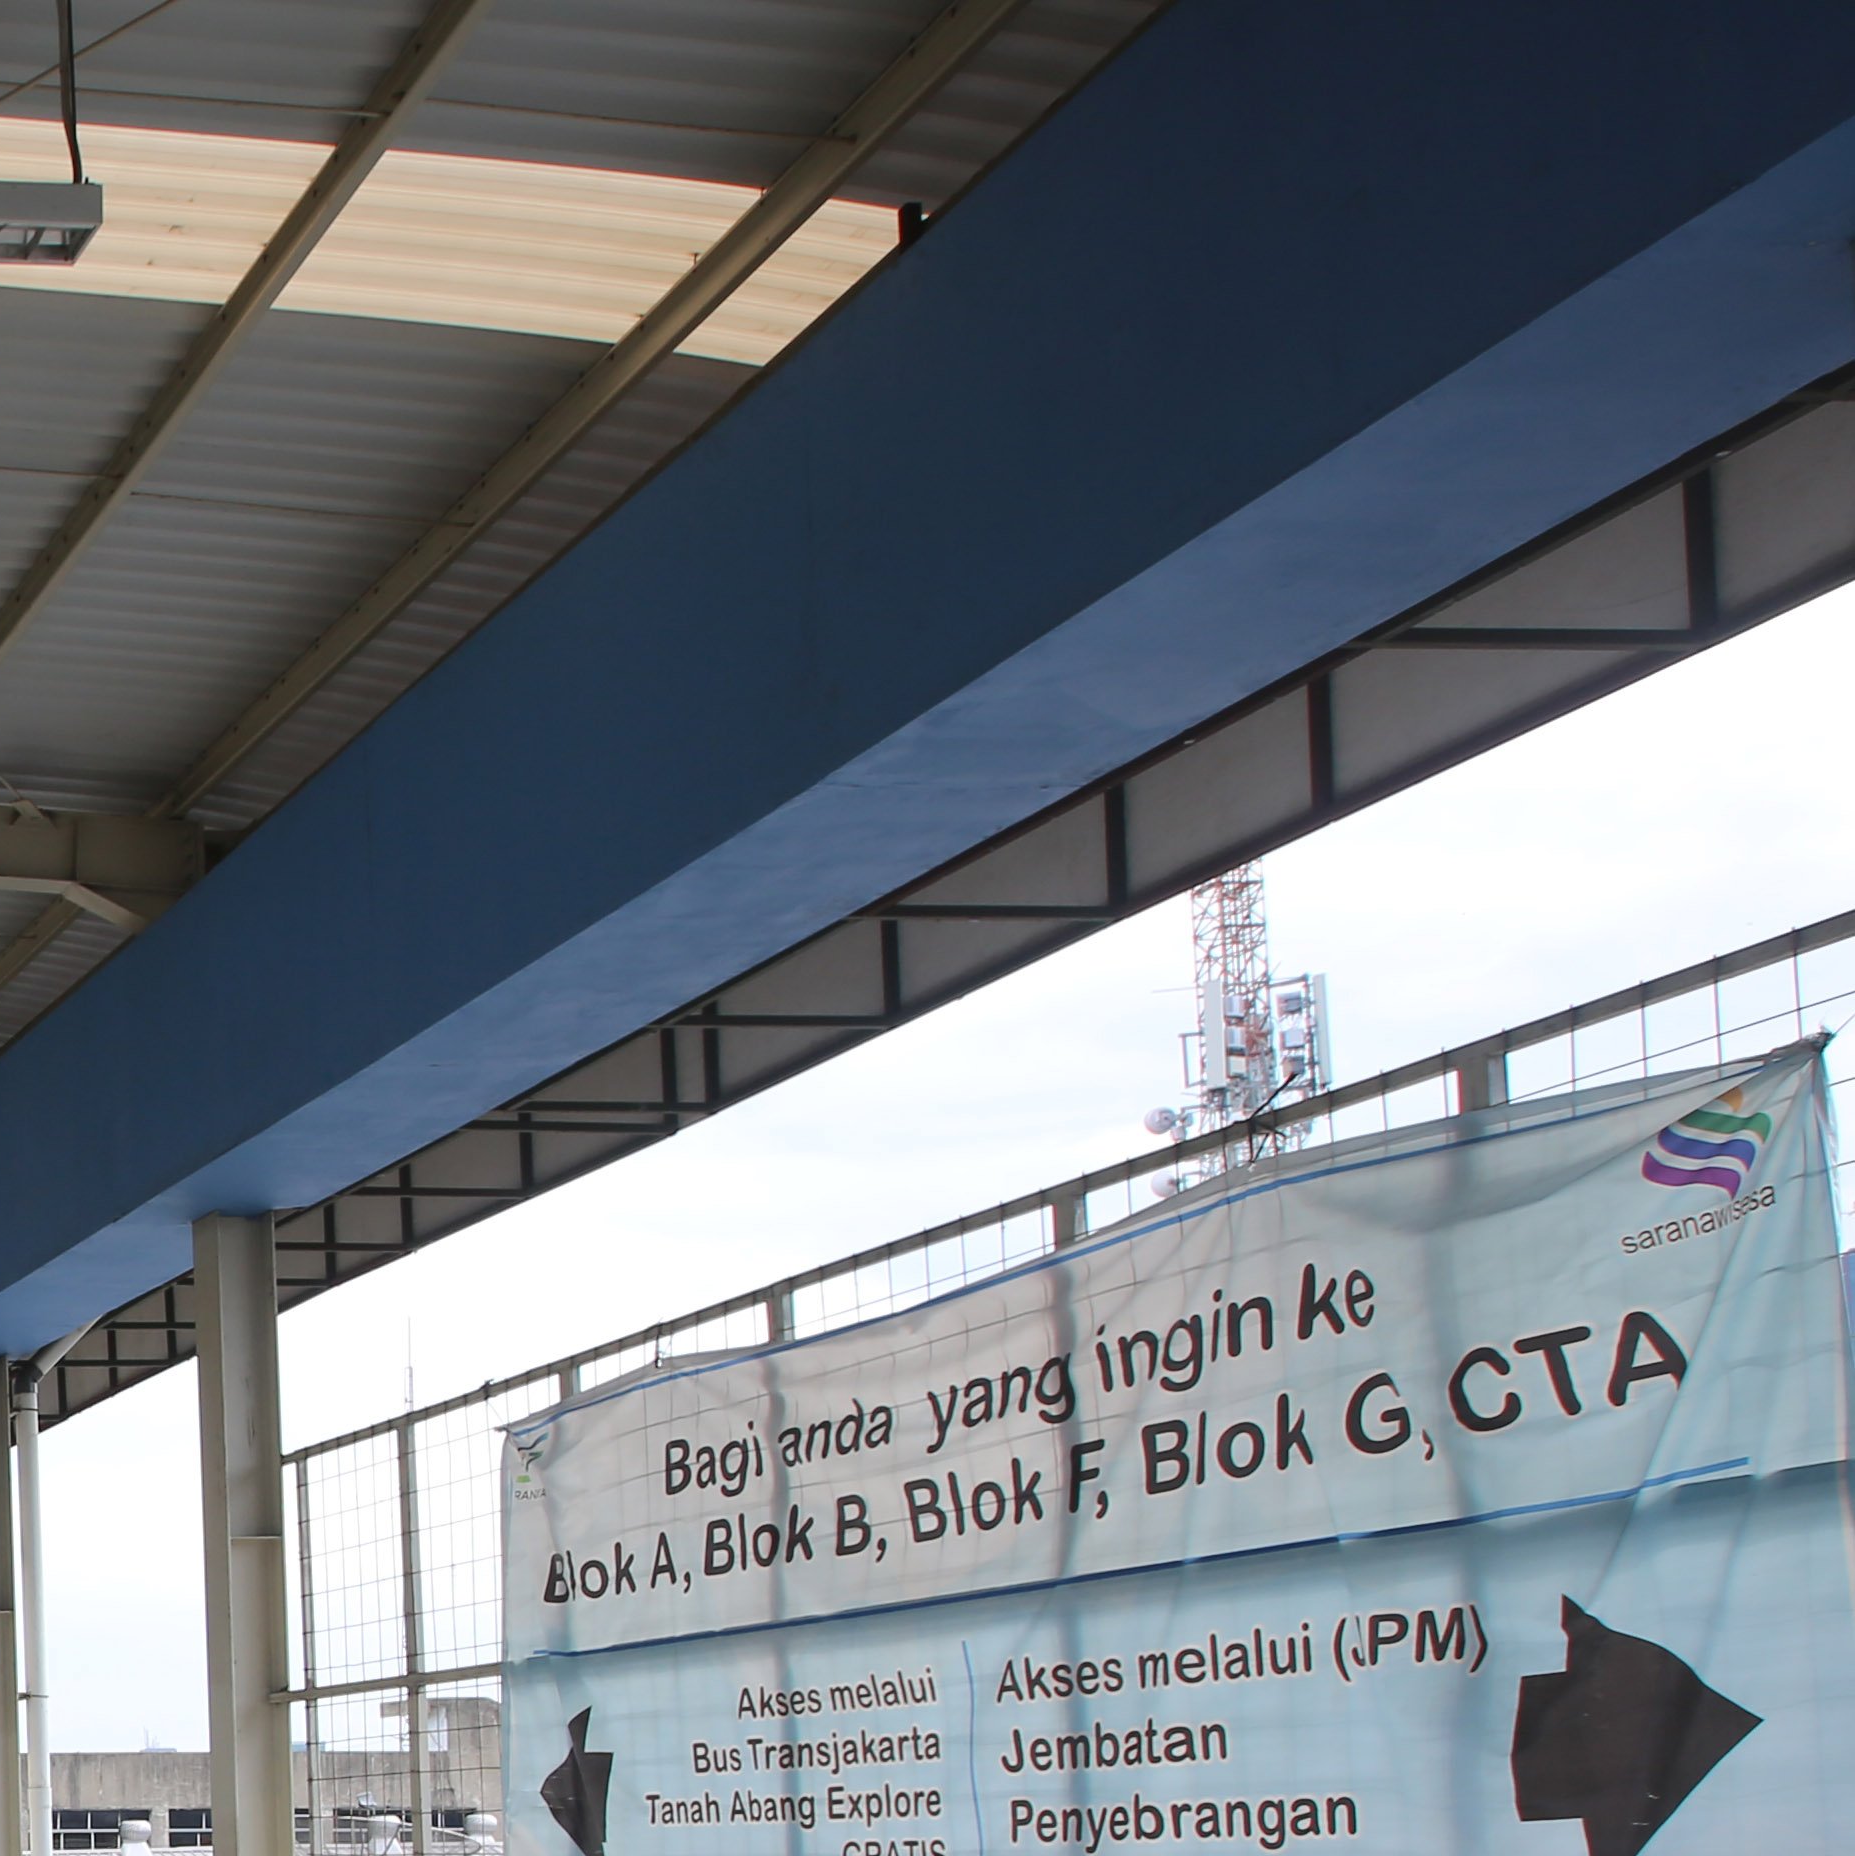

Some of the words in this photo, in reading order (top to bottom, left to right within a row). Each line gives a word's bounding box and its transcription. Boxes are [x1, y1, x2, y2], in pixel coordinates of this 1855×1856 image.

[665, 1420, 763, 1497] Bagi
[778, 1398, 892, 1467] anda
[926, 1352, 1075, 1454] yang
[1095, 1289, 1273, 1392] ingin
[1297, 1263, 1374, 1340] ke
[544, 1542, 636, 1603] Blok
[650, 1532, 692, 1594] A,
[704, 1505, 814, 1576] Blok
[835, 1494, 887, 1562] B,
[904, 1457, 1043, 1543] Blok
[1069, 1438, 1109, 1519] F,
[1142, 1393, 1313, 1494] Blok
[1346, 1372, 1435, 1461] G,
[1448, 1311, 1688, 1432] CTA
[996, 1657, 1124, 1703] Akses
[1138, 1622, 1313, 1689] melalui
[738, 1686, 822, 1720] Akses
[829, 1667, 938, 1711] melalui
[692, 1742, 741, 1773] Bus
[746, 1726, 941, 1775] Transjakarta
[1001, 1718, 1228, 1773] Jembatan
[645, 1793, 721, 1825] Tanah
[730, 1790, 815, 1830] Abang
[827, 1783, 941, 1827] Explore
[1011, 1794, 1358, 1854] Penyebrangan
